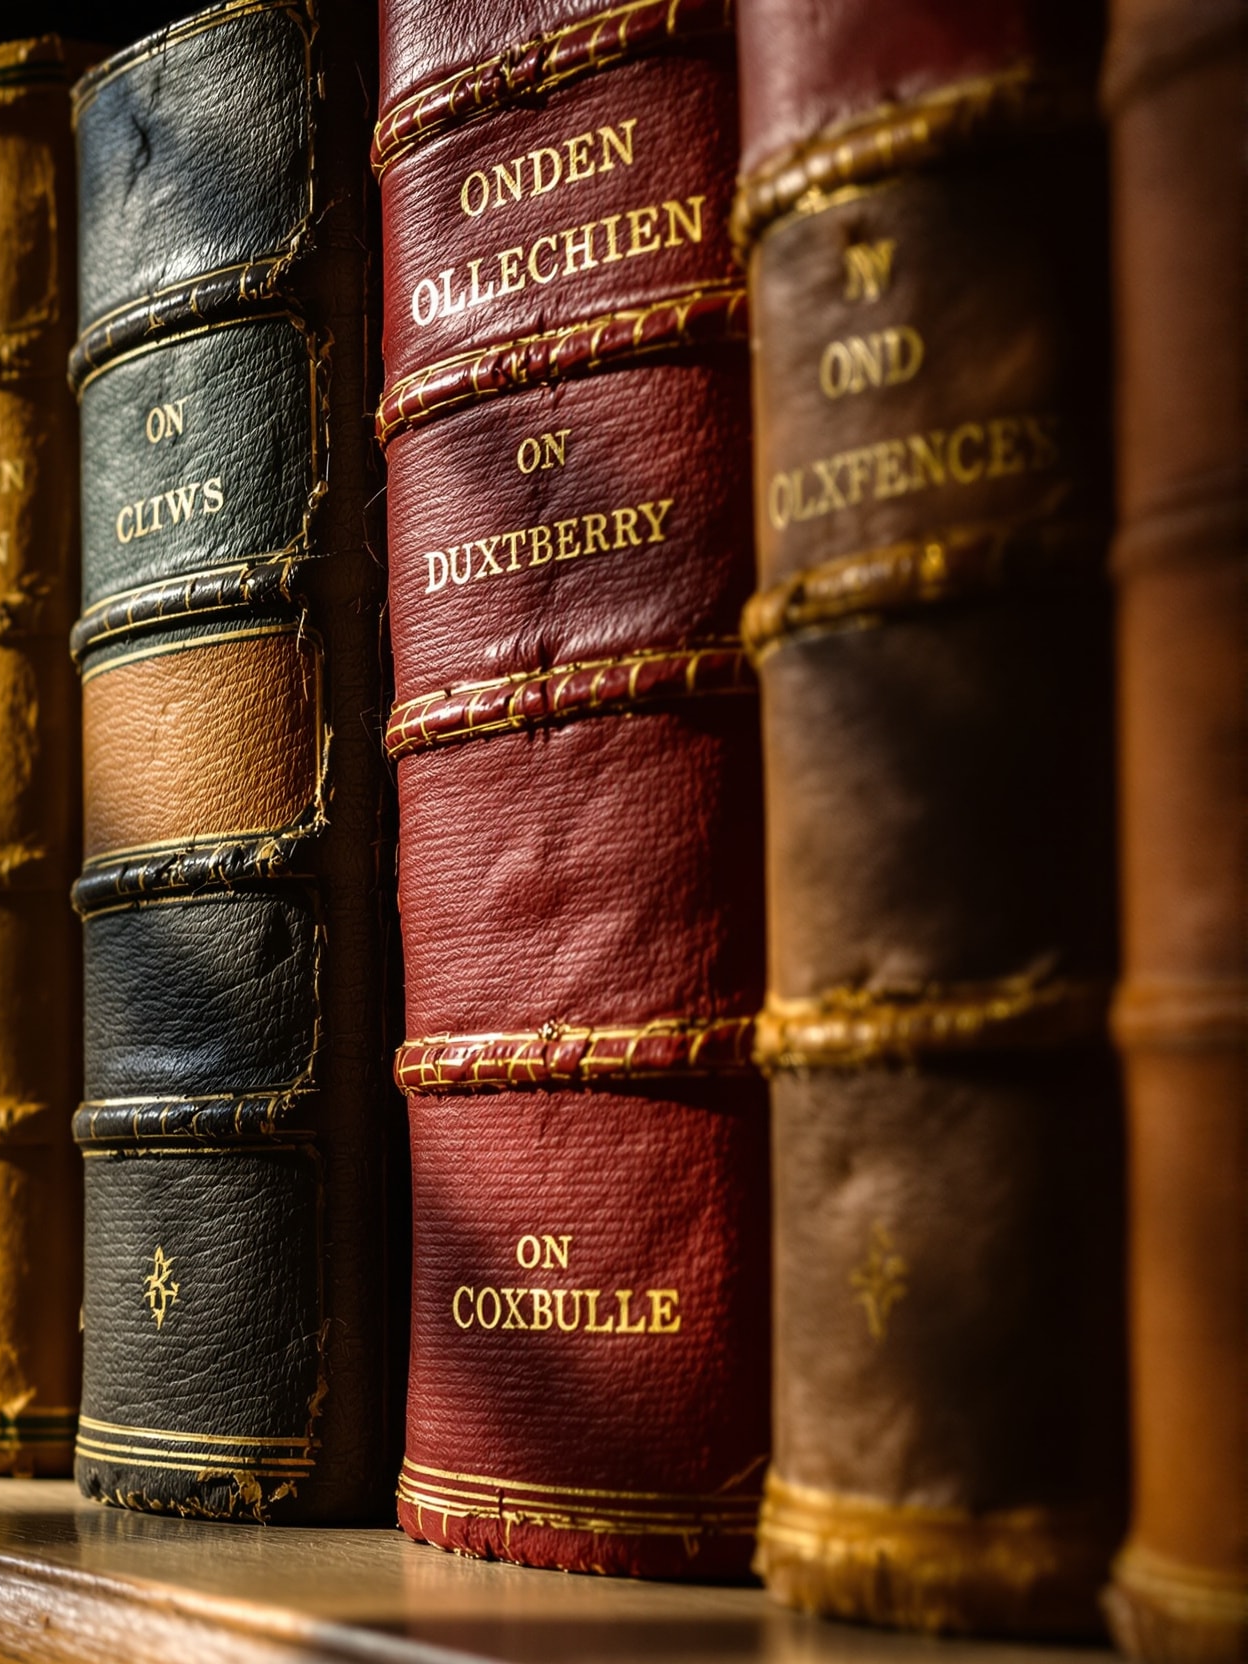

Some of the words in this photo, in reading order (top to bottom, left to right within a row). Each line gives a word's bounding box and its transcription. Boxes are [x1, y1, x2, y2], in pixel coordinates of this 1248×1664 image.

[460, 118, 638, 217] ONDEN
[411, 195, 706, 327] OLLECHIEN
[145, 396, 188, 444] ON
[516, 429, 571, 474] ON
[116, 476, 224, 544] CLIWS
[423, 499, 673, 595] DUXTBERRY
[516, 1235, 572, 1270] ON
[452, 1285, 681, 1334] COXBULLE
